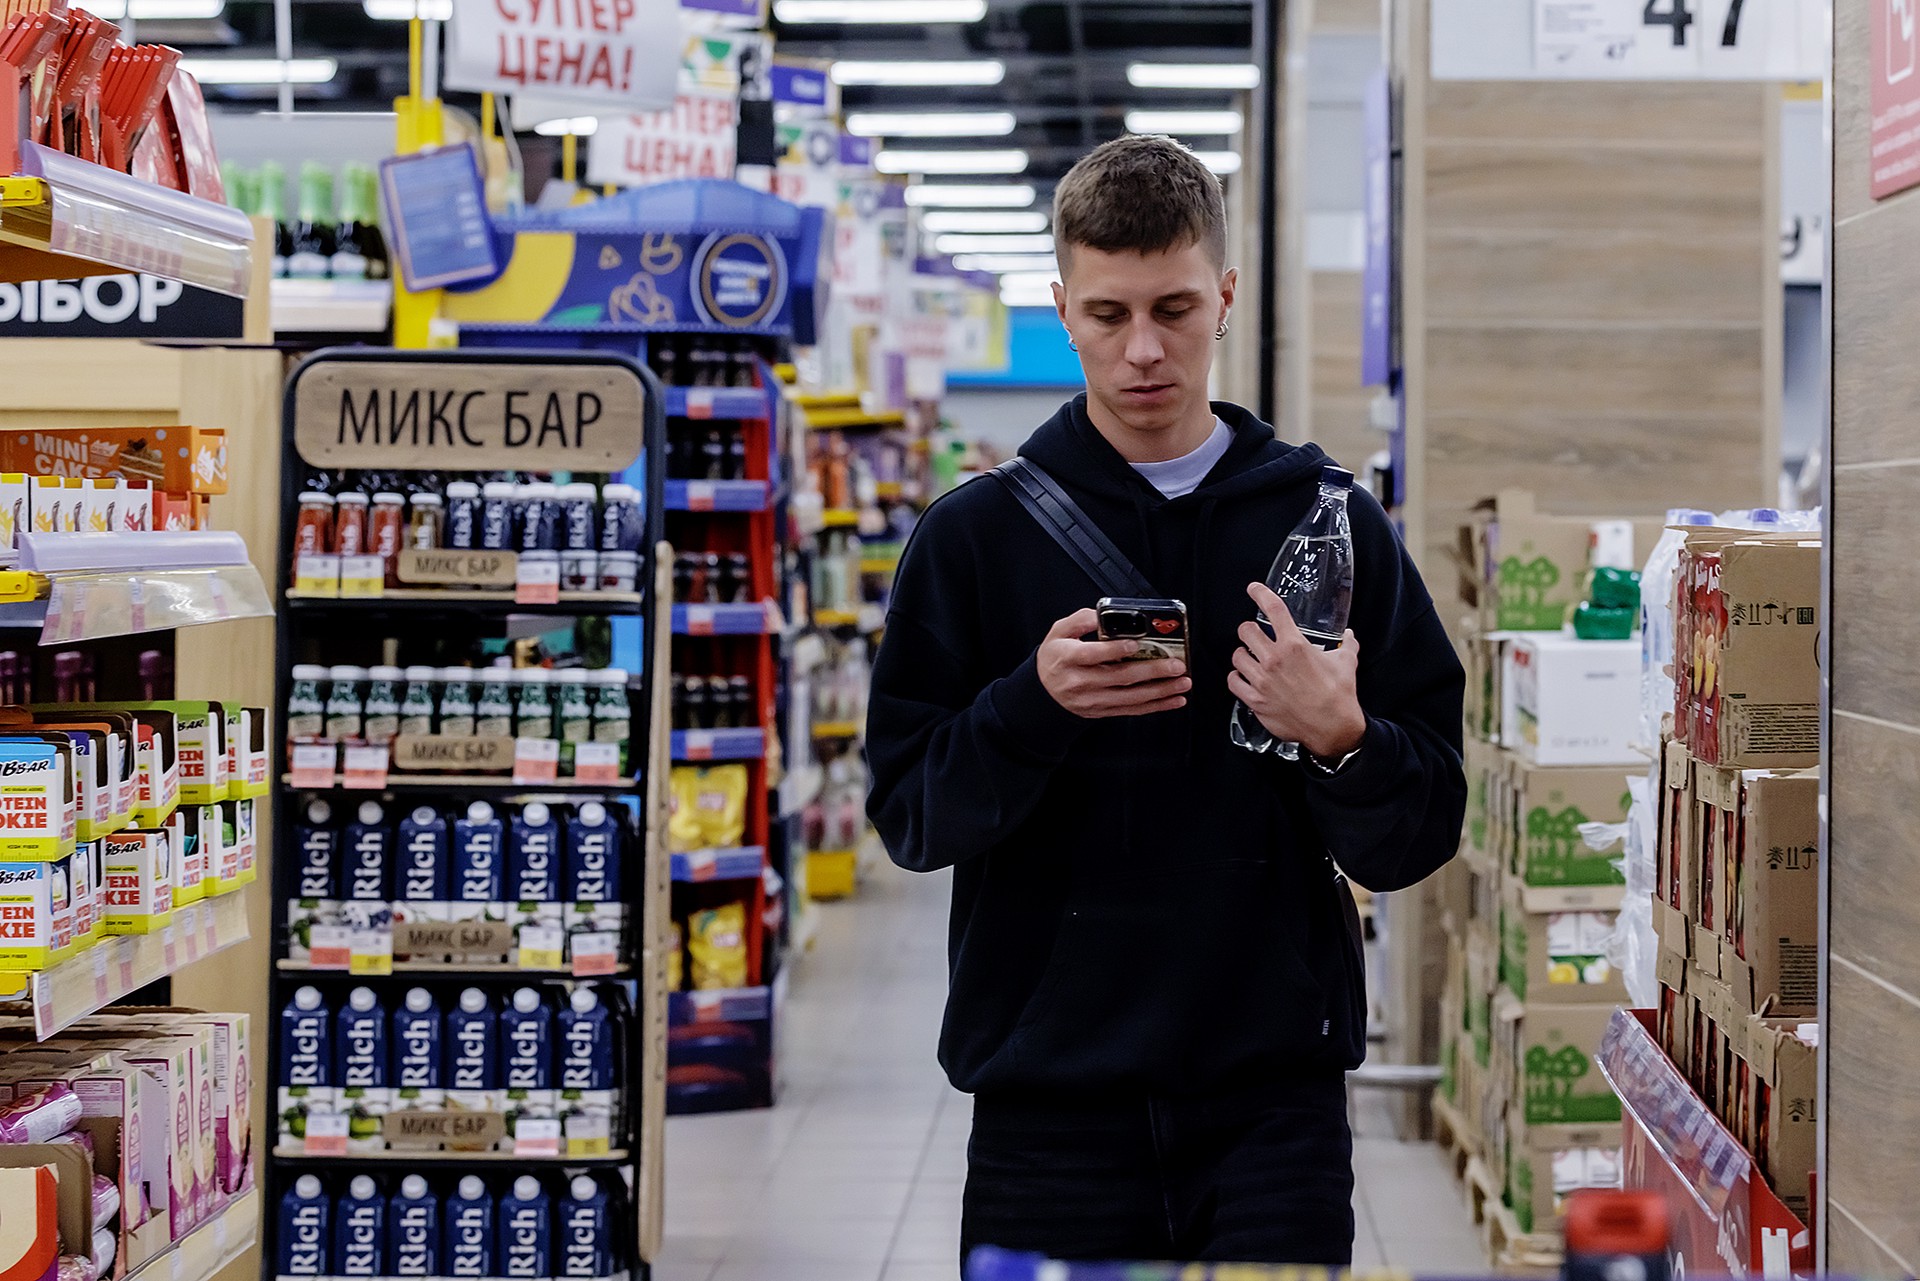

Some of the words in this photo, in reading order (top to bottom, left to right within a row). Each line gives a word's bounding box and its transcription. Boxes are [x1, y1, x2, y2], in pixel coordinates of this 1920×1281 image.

[498, 34, 632, 90] ЦЕНА!
[338, 388, 486, 446] МИКС
[504, 391, 602, 448] БАР
[35, 453, 102, 478] CAKE
[0, 761, 49, 777] BBAR
[0, 797, 47, 810] TEIN
[301, 831, 331, 897] Rich
[353, 832, 383, 899] Rich
[406, 832, 436, 900] Rich
[462, 834, 492, 900] Rich
[519, 834, 548, 901] Rich
[576, 834, 605, 901] Rich
[0, 907, 34, 919] EIN
[290, 1019, 319, 1084] Rich
[346, 1019, 375, 1086] Rich
[401, 1020, 431, 1087] Rich
[455, 1021, 485, 1088] Rich
[509, 1021, 538, 1088] Rich
[563, 1021, 593, 1088] Rich
[290, 1206, 319, 1274] Rich
[345, 1207, 375, 1275] Rich
[399, 1207, 427, 1276] Rich
[454, 1207, 483, 1276] Rich
[508, 1208, 538, 1276] Rich
[566, 1208, 595, 1276] Rich
